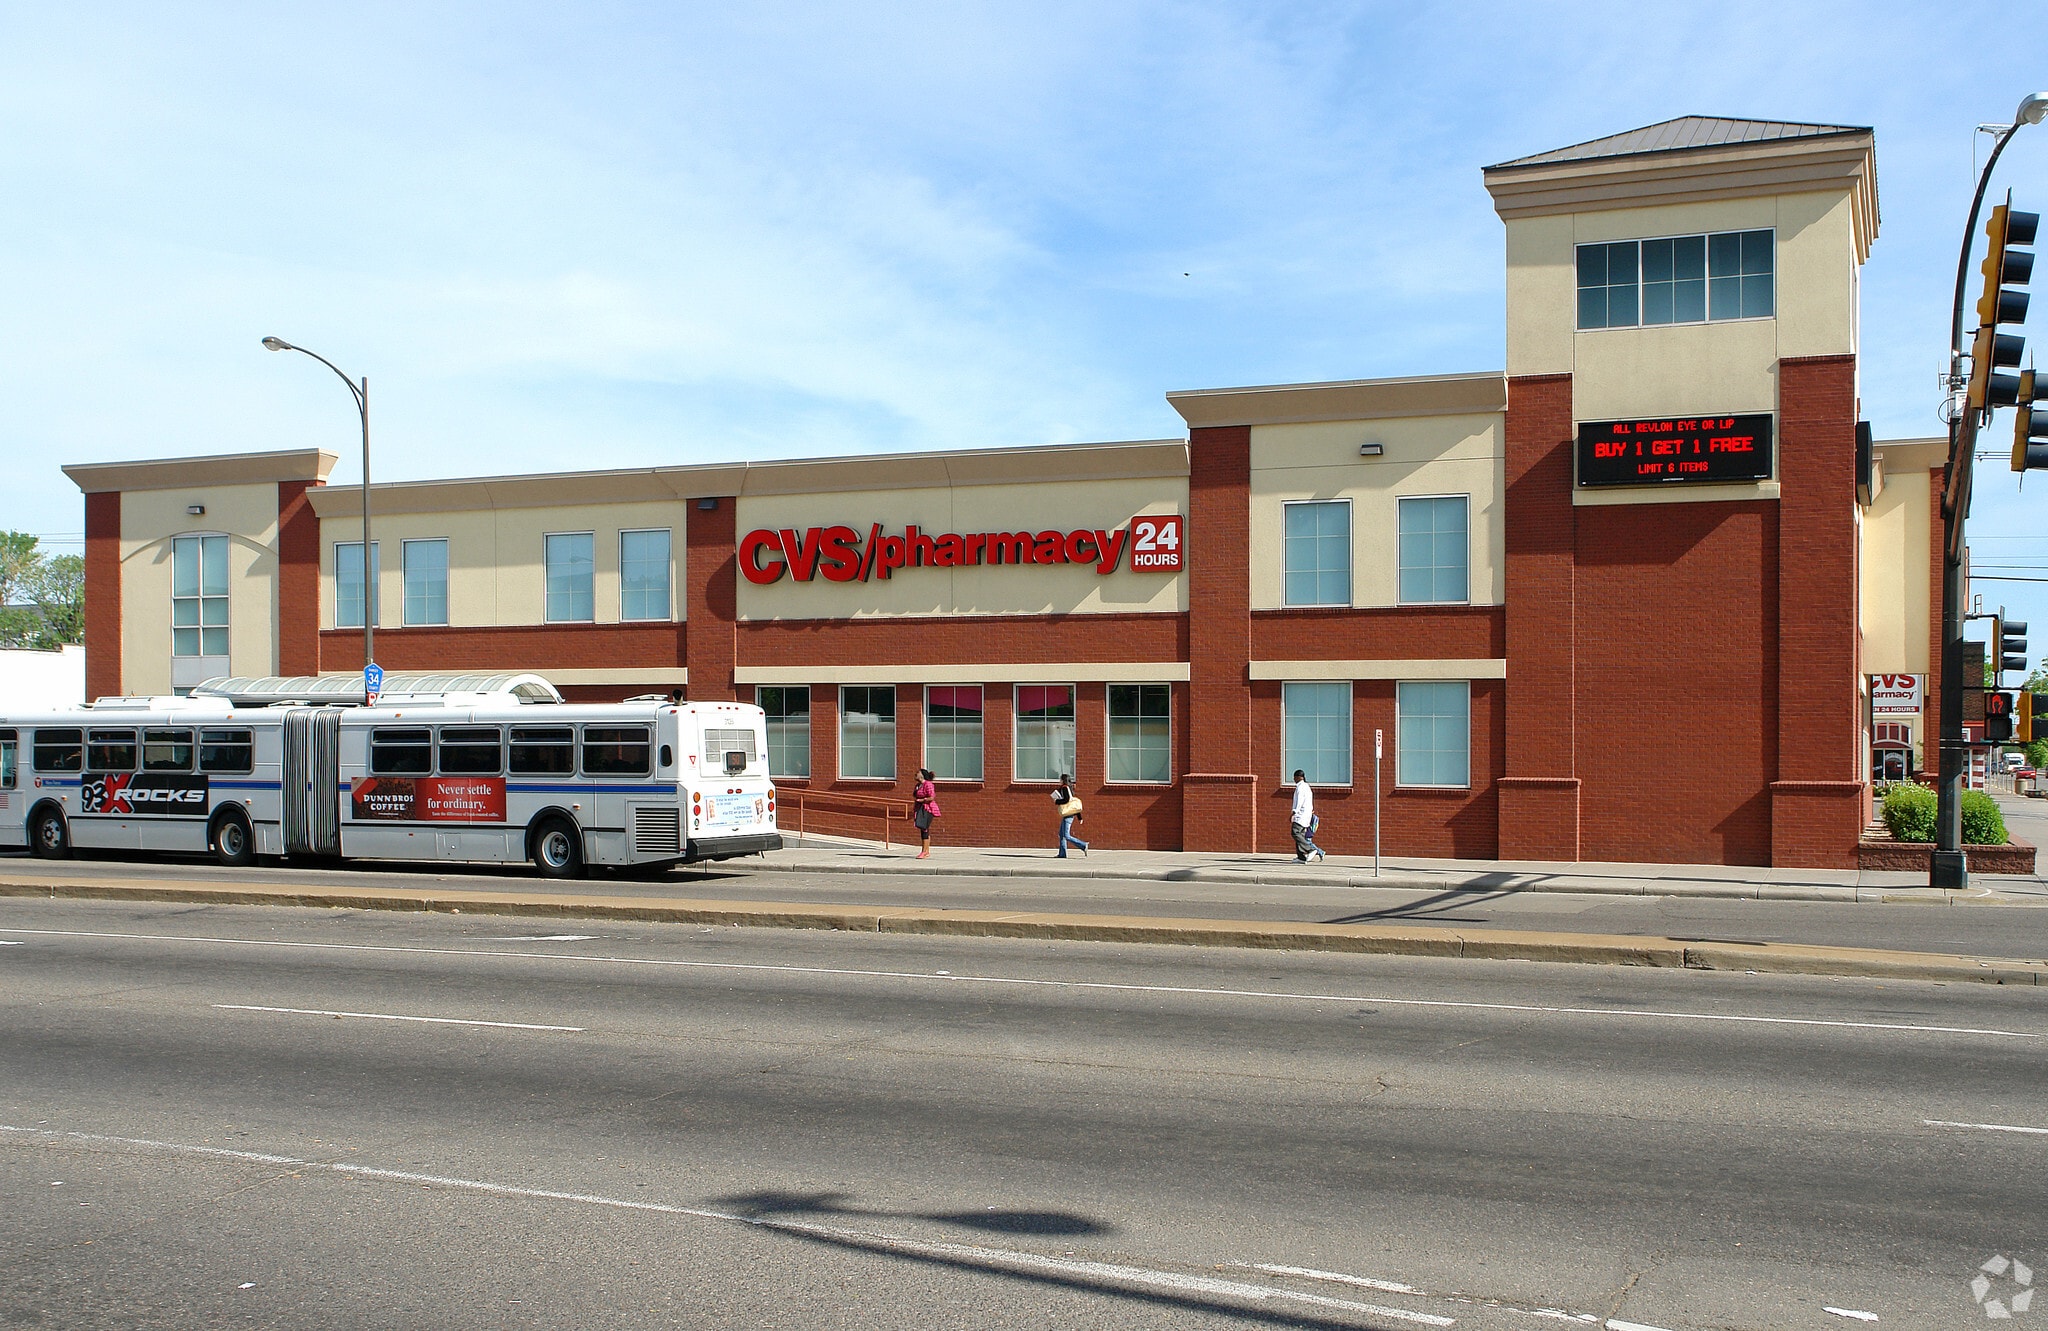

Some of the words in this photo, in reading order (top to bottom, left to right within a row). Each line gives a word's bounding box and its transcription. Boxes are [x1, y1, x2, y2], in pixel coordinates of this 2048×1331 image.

[1613, 424, 1631, 434] ALL
[1636, 421, 1673, 433] REVLON
[1677, 421, 1698, 433] EYE
[1702, 419, 1715, 430] OR
[1719, 419, 1735, 429] LIP
[1595, 442, 1627, 458] BUY
[1635, 441, 1643, 456] 1
[1651, 439, 1684, 455] GET
[1693, 440, 1701, 454] 1
[1709, 436, 1754, 453] FREE
[1638, 463, 1663, 474] LIMIT
[1667, 463, 1675, 473] 6
[1679, 461, 1709, 473] ITEMS
[1135, 522, 1179, 551] 24
[738, 522, 1130, 586] CVS/pharmacy
[1134, 552, 1179, 567] HOURS
[368, 673, 379, 685] 34
[1872, 690, 1915, 700] armacy
[113, 788, 206, 803] ROCKS
[437, 783, 465, 795] Never
[466, 783, 492, 796] settle
[370, 803, 406, 811] COFFEE
[427, 797, 441, 809] for
[442, 798, 486, 812] ordinary.
